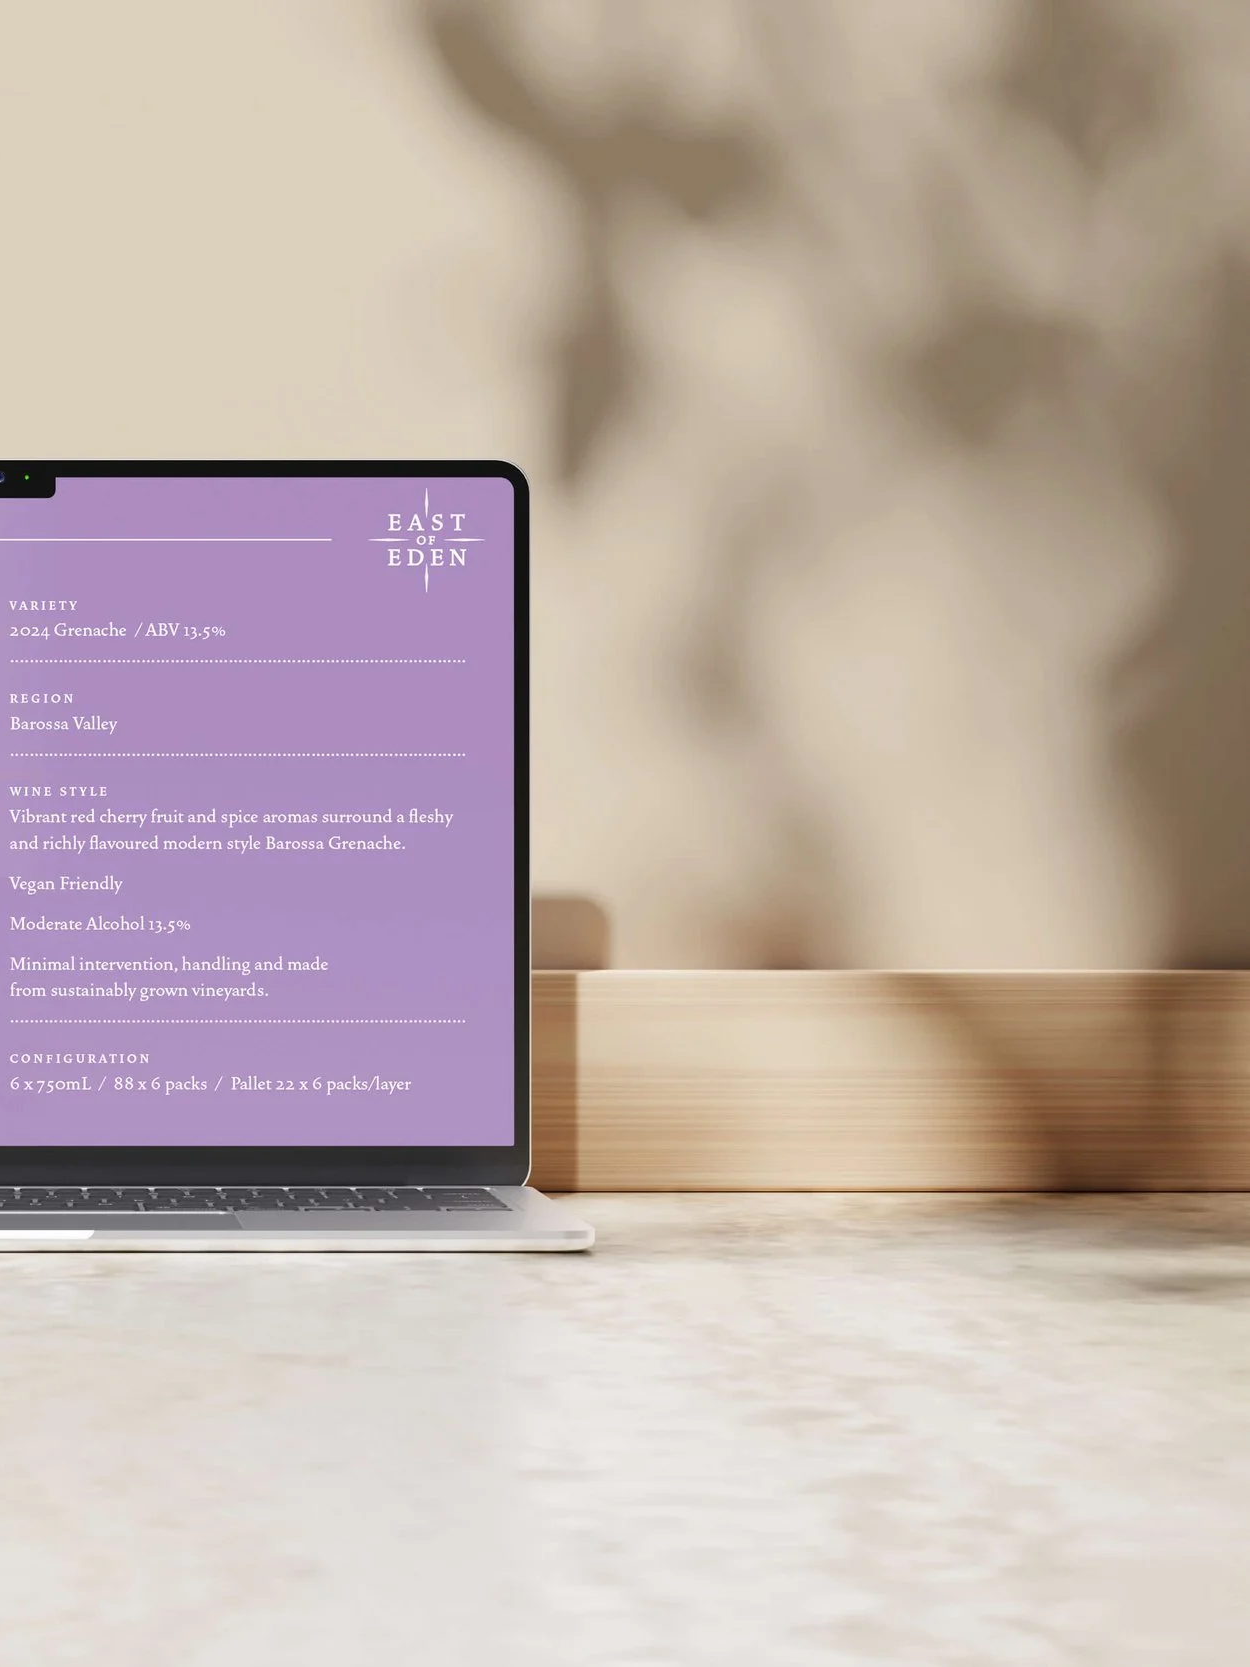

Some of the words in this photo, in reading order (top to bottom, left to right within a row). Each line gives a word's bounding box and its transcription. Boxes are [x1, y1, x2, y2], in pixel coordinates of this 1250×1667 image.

[387, 513, 466, 532] EAST
[415, 534, 436, 546] OF
[387, 548, 467, 567] EDEN
[8, 600, 78, 611] VARIETY
[9, 626, 51, 641] 2024
[53, 621, 127, 637] Grenache
[183, 625, 226, 640] 13.5%
[9, 693, 74, 704] REGION
[9, 716, 70, 731] Barossa
[71, 715, 118, 736] Valley
[9, 786, 52, 797] WINE
[59, 786, 108, 797] STYLE
[8, 807, 68, 824] Vibrant
[70, 808, 96, 824] red
[99, 807, 148, 829] cherry
[150, 807, 185, 824] fruit
[187, 807, 217, 824] and
[220, 809, 259, 829] spice
[262, 813, 318, 824] aromas
[321, 807, 393, 824] surround
[396, 813, 406, 824] a
[408, 807, 454, 828] fleshy
[9, 834, 39, 850] and
[42, 834, 87, 855] richly
[89, 834, 159, 850] flavoured
[162, 834, 223, 850] modern
[226, 834, 261, 855] style
[265, 835, 325, 850] Barossa
[328, 834, 406, 850] Grenache.
[8, 875, 56, 896] Vegan
[59, 875, 124, 896] Friendly
[9, 915, 83, 931] Moderate
[84, 915, 145, 931] Alcohol
[148, 919, 191, 934] 13.5%
[9, 955, 76, 971] Minimal
[79, 956, 179, 973] intervention,
[181, 955, 251, 976] handling
[254, 955, 284, 971] and
[287, 955, 329, 971] made
[9, 981, 47, 997] from
[50, 981, 138, 1002] sustainably
[139, 986, 189, 1002] grown
[190, 981, 269, 1002] vineyards.
[9, 1053, 150, 1064] CONFIGURATION
[10, 1076, 20, 1091] 6
[23, 1080, 34, 1091] x
[36, 1076, 92, 1094] 750mL
[113, 1076, 134, 1091] 88
[137, 1080, 147, 1091] x
[150, 1076, 161, 1091] 6
[165, 1075, 208, 1096] packs
[230, 1075, 273, 1091] Pallet
[275, 1080, 295, 1091] 22
[298, 1080, 309, 1091] x
[312, 1076, 322, 1091] 6
[326, 1074, 412, 1096] packs/layer
